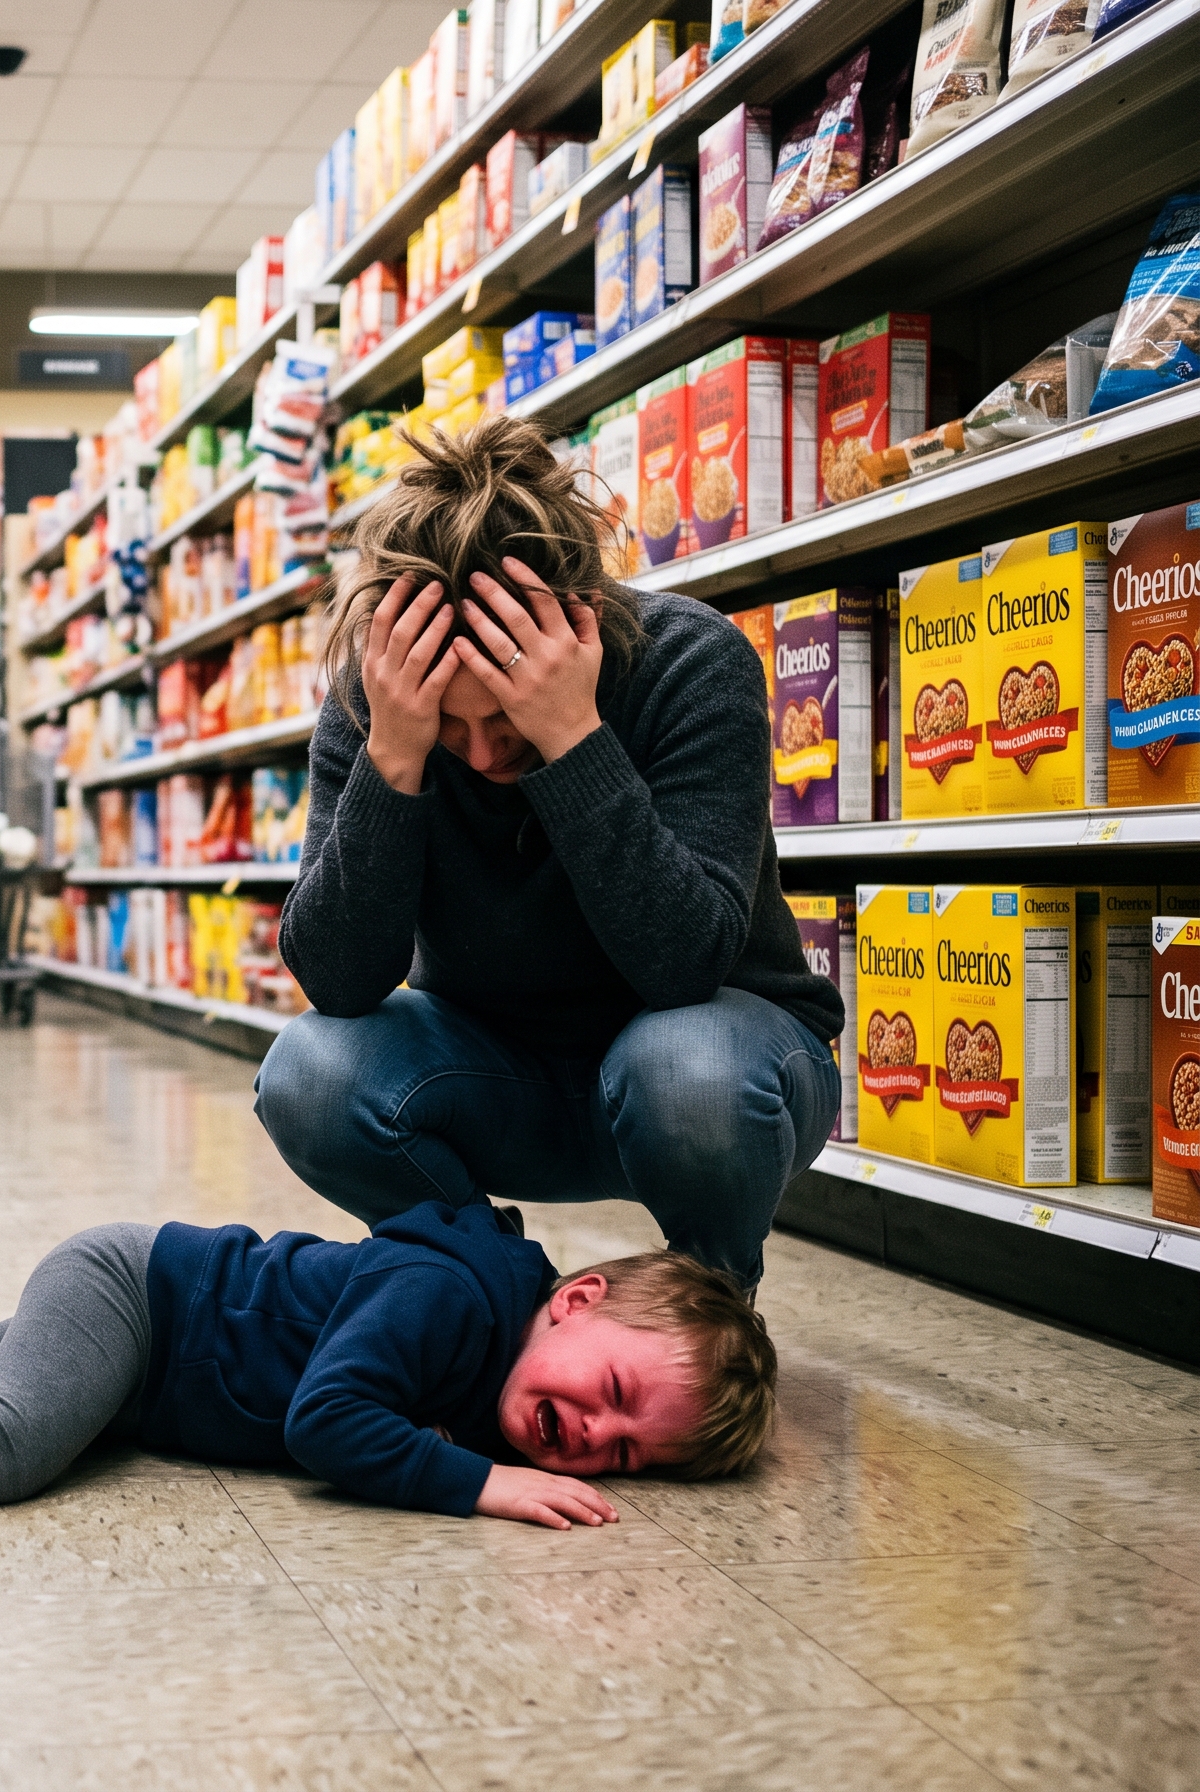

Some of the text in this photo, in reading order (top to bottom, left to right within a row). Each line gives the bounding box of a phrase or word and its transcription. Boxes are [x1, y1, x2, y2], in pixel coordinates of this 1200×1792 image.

[905, 605, 976, 655] Cheerios
[987, 581, 1070, 636] Cheerios
[775, 637, 831, 680] Cheerios
[859, 935, 925, 980] Cheerios
[937, 939, 1011, 987] Cheerios
